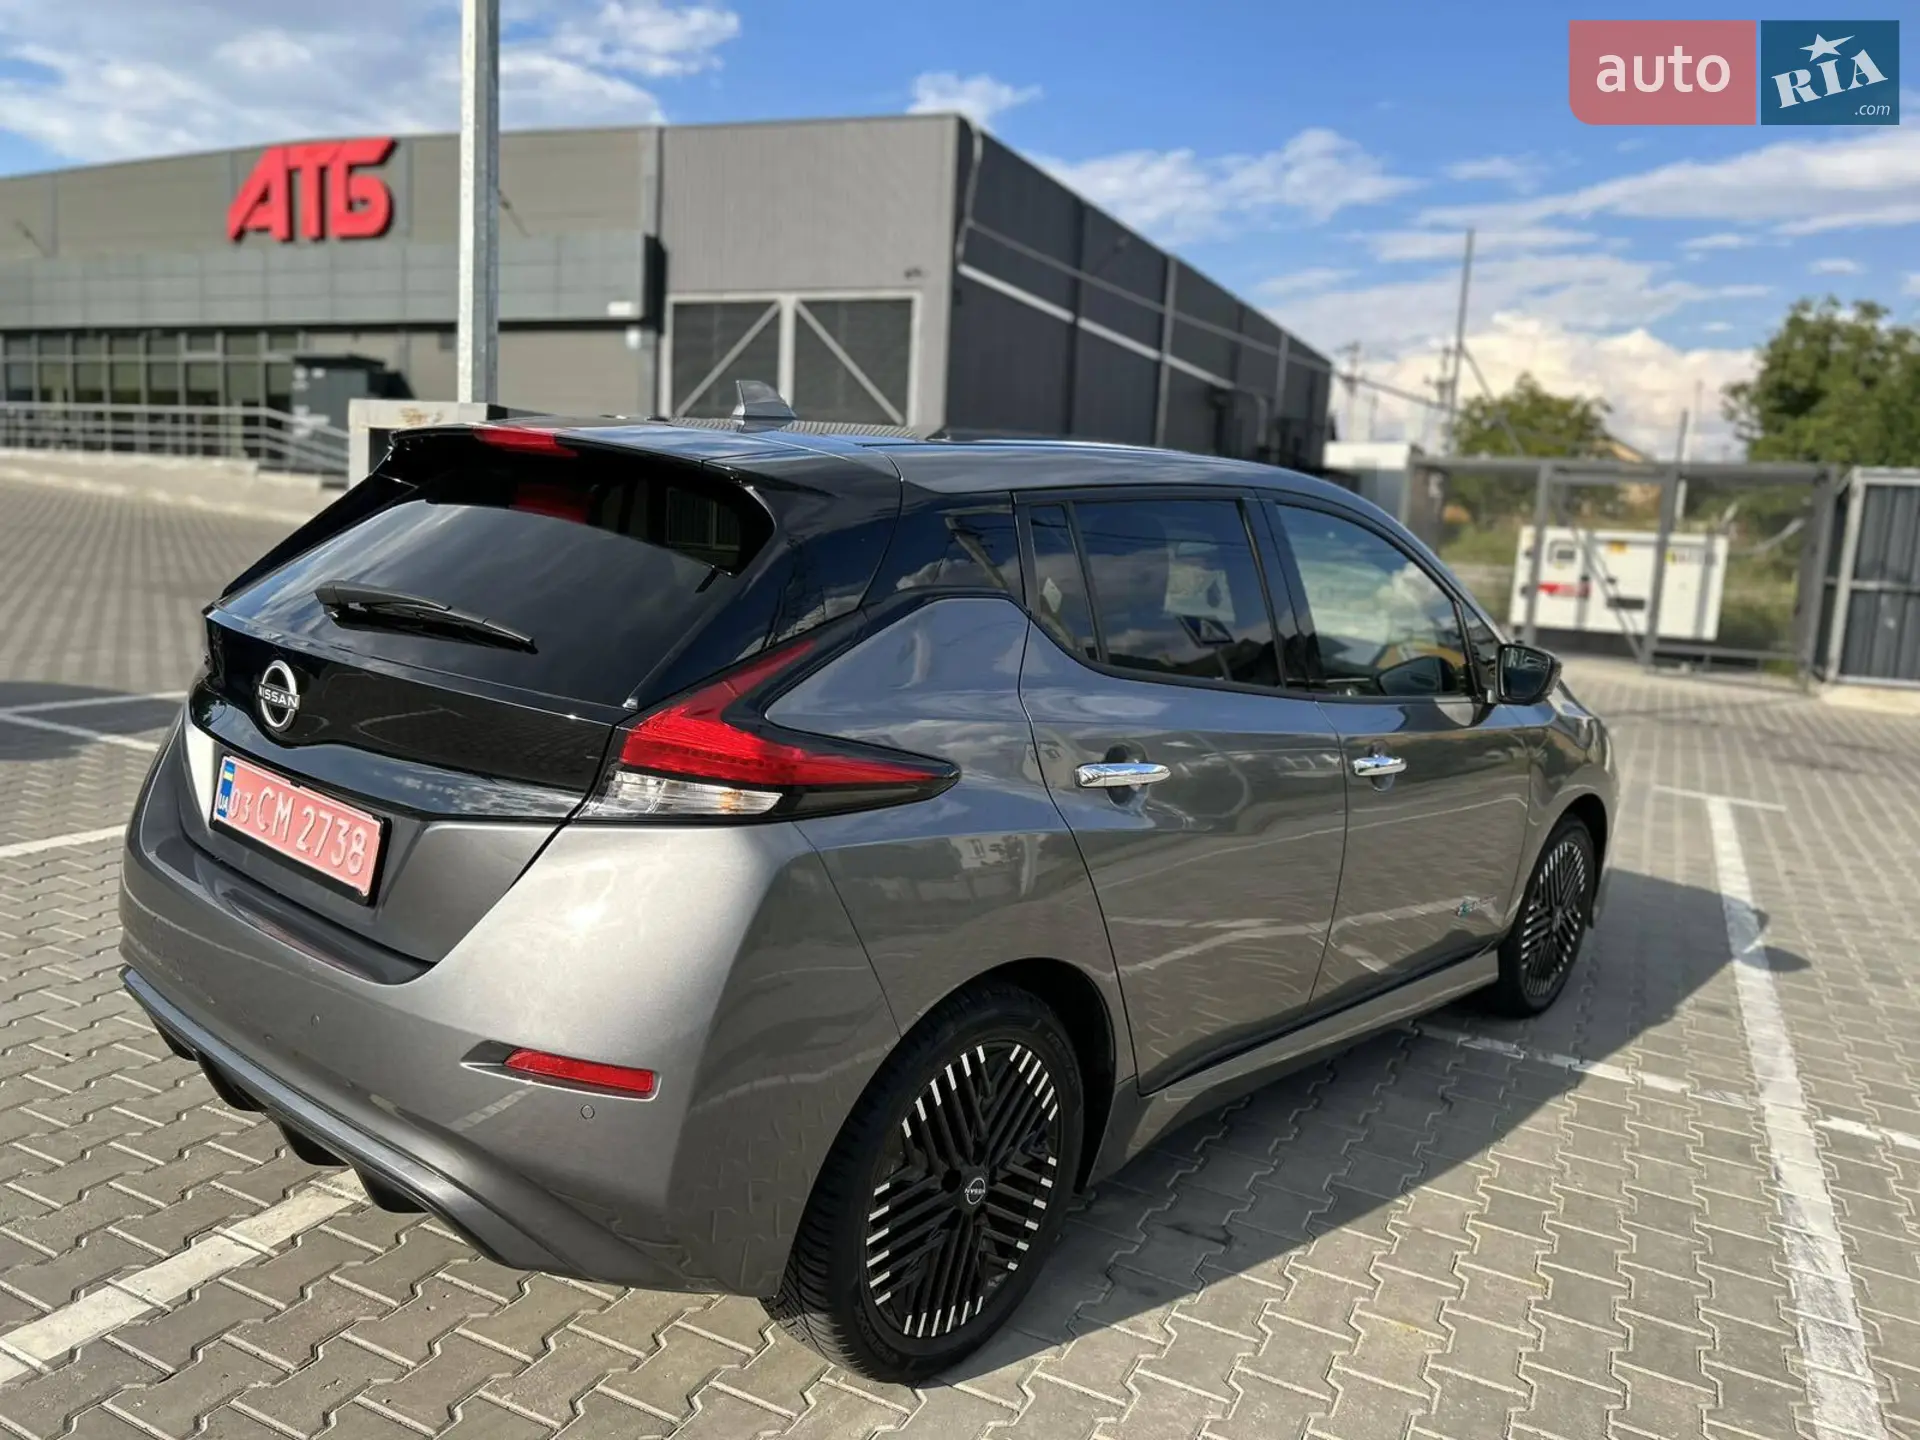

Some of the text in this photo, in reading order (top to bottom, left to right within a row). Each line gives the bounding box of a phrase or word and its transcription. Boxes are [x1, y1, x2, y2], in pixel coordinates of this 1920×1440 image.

[227, 136, 396, 244] АТБ
[258, 684, 299, 708] NISSAN
[229, 786, 368, 877] 03 CM 2738
